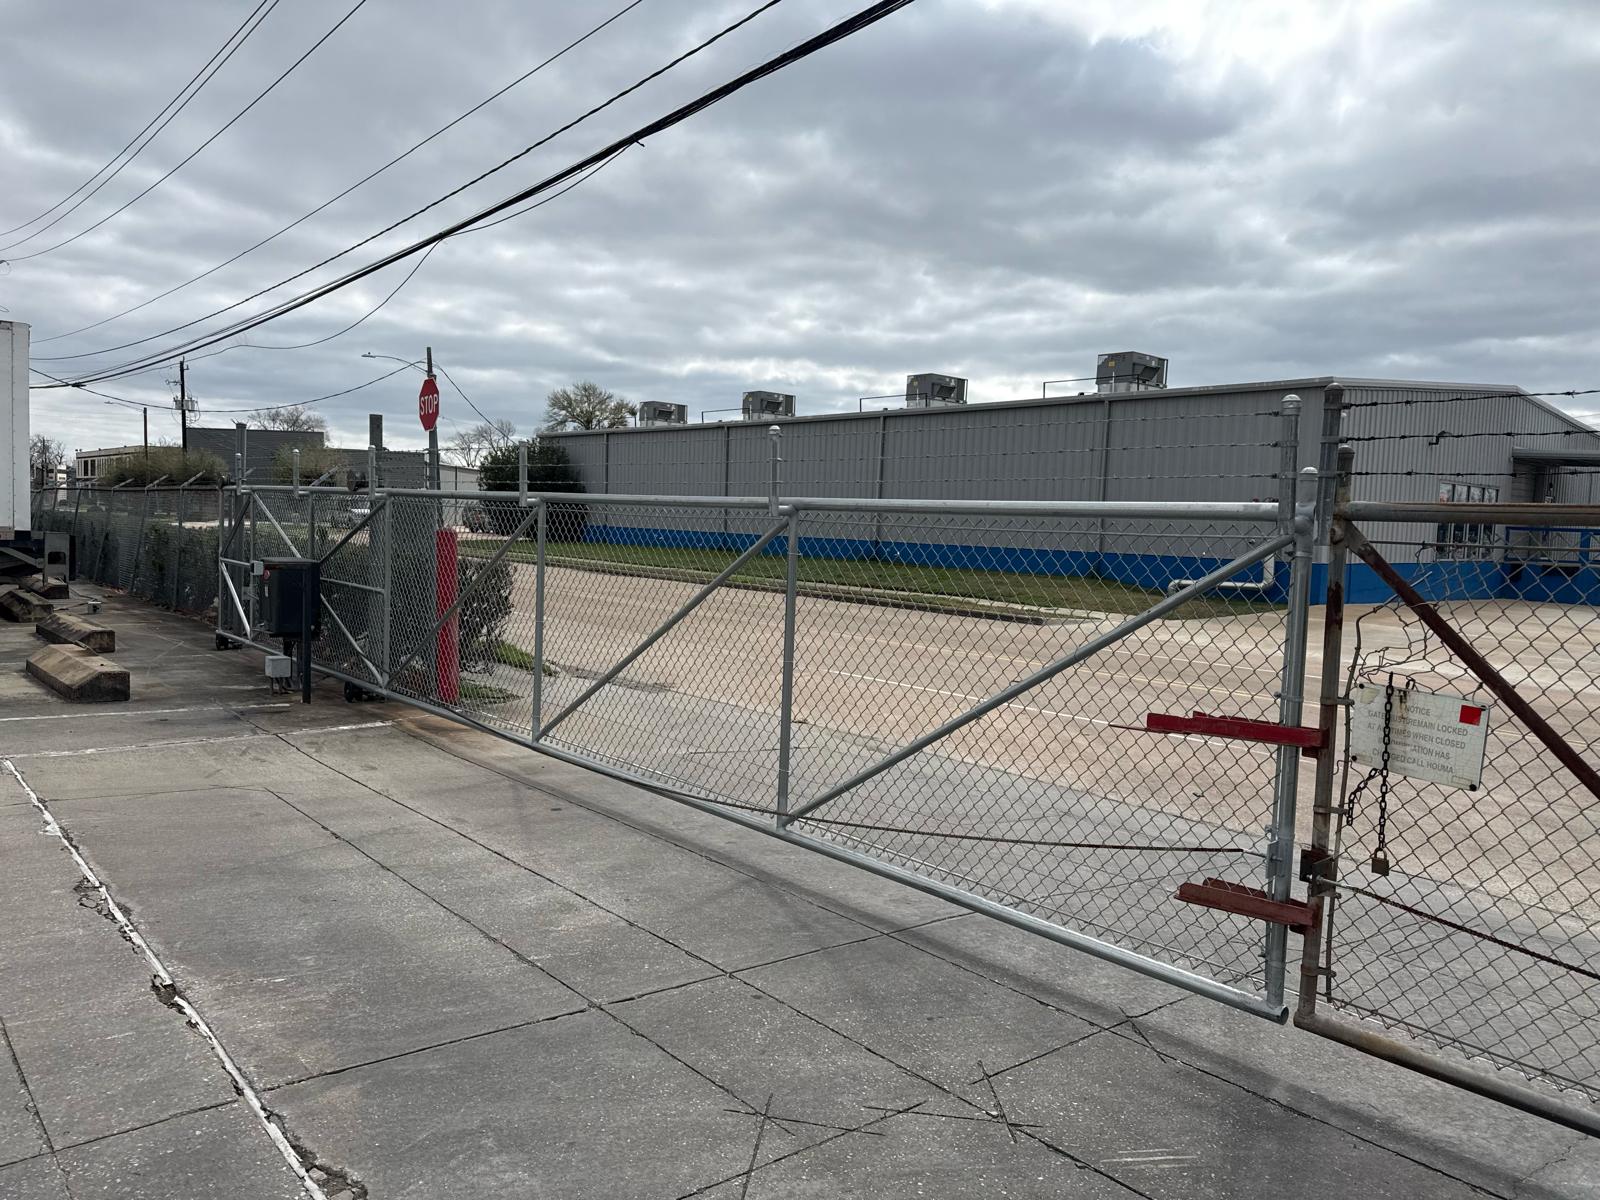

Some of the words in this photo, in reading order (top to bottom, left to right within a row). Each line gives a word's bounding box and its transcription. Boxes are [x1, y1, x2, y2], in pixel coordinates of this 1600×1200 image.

[420, 393, 438, 415] STOP
[1405, 705, 1431, 717] NOTICE
[1368, 710, 1385, 720] GATE
[1436, 723, 1469, 737] LOCKED
[1391, 727, 1412, 738] TIMES
[1412, 731, 1434, 743] WHEN
[1435, 736, 1466, 750] CLOSED
[1406, 756, 1425, 768] CALL
[1434, 750, 1450, 760] HAS
